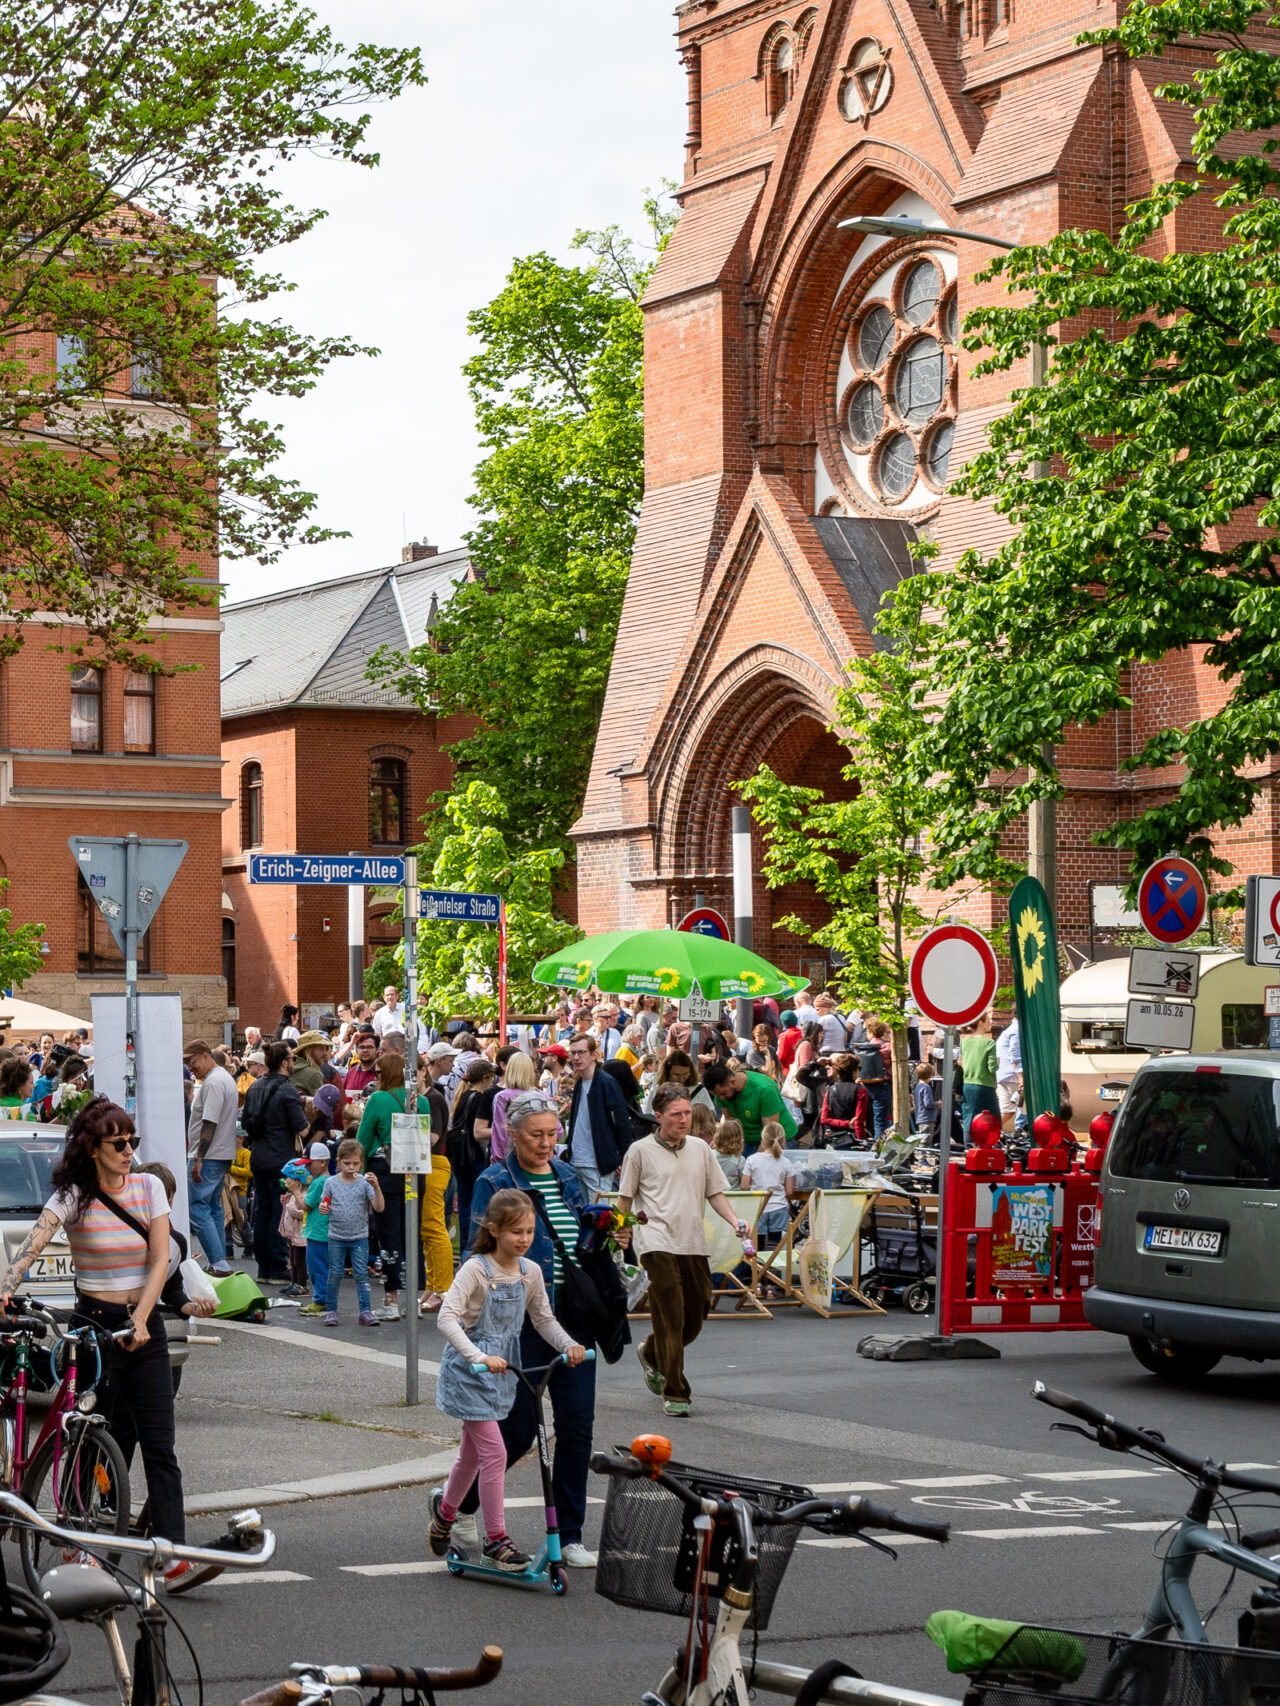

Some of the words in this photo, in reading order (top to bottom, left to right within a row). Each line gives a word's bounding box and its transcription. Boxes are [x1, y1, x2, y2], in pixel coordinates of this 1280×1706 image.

[259, 858, 398, 883] Erich-Zeigner-Allee
[421, 895, 467, 916] eißenfelser
[470, 898, 496, 917] Straße
[1140, 1005, 1151, 1014] am
[1154, 1004, 1184, 1018] 10.05.26
[1012, 1202, 1053, 1221] WEST
[1011, 1217, 1050, 1237] PARK
[1014, 1234, 1047, 1255] FEST
[1070, 1243, 1095, 1251] Westk
[1153, 1228, 1173, 1245] MEI
[1181, 1231, 1195, 1248] CK
[1197, 1233, 1219, 1250] 632
[36, 1259, 46, 1275] Z
[56, 1258, 67, 1274] M
